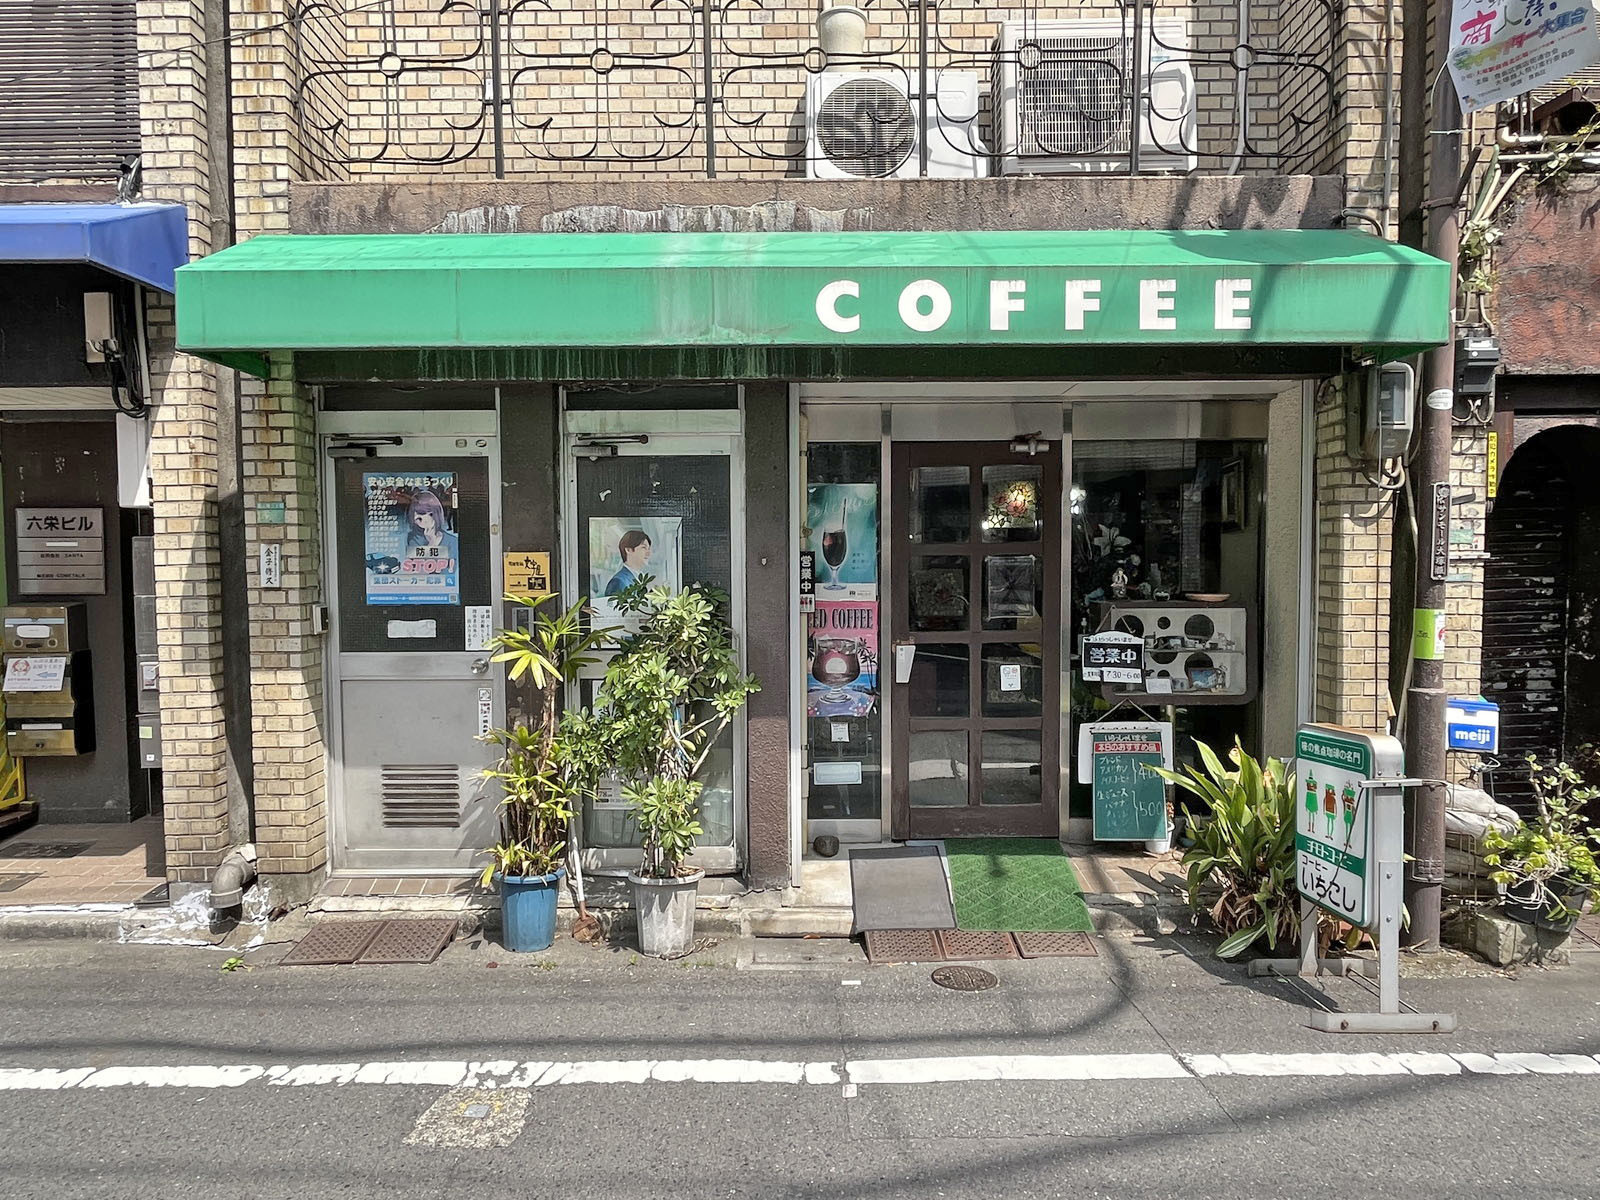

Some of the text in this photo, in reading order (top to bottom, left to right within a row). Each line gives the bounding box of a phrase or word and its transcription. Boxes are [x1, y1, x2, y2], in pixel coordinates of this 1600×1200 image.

[815, 279, 1252, 333] COFFEE
[367, 476, 453, 487] 安心安全なまちづくり
[26, 515, 93, 531] 六栄ビル
[415, 547, 439, 557] 防犯
[402, 559, 455, 573] STOP!
[801, 555, 812, 592] 営業中
[831, 608, 873, 630] COFFEE
[1089, 647, 1137, 664] 営業中
[1455, 729, 1490, 745] meiji
[1098, 743, 1157, 751] 本日のおすすめ品
[1301, 741, 1361, 765] 味の焦点珈琲の名門
[1139, 801, 1161, 817] 500
[1302, 854, 1329, 872] コーヒー
[1302, 866, 1356, 913] いちこし
